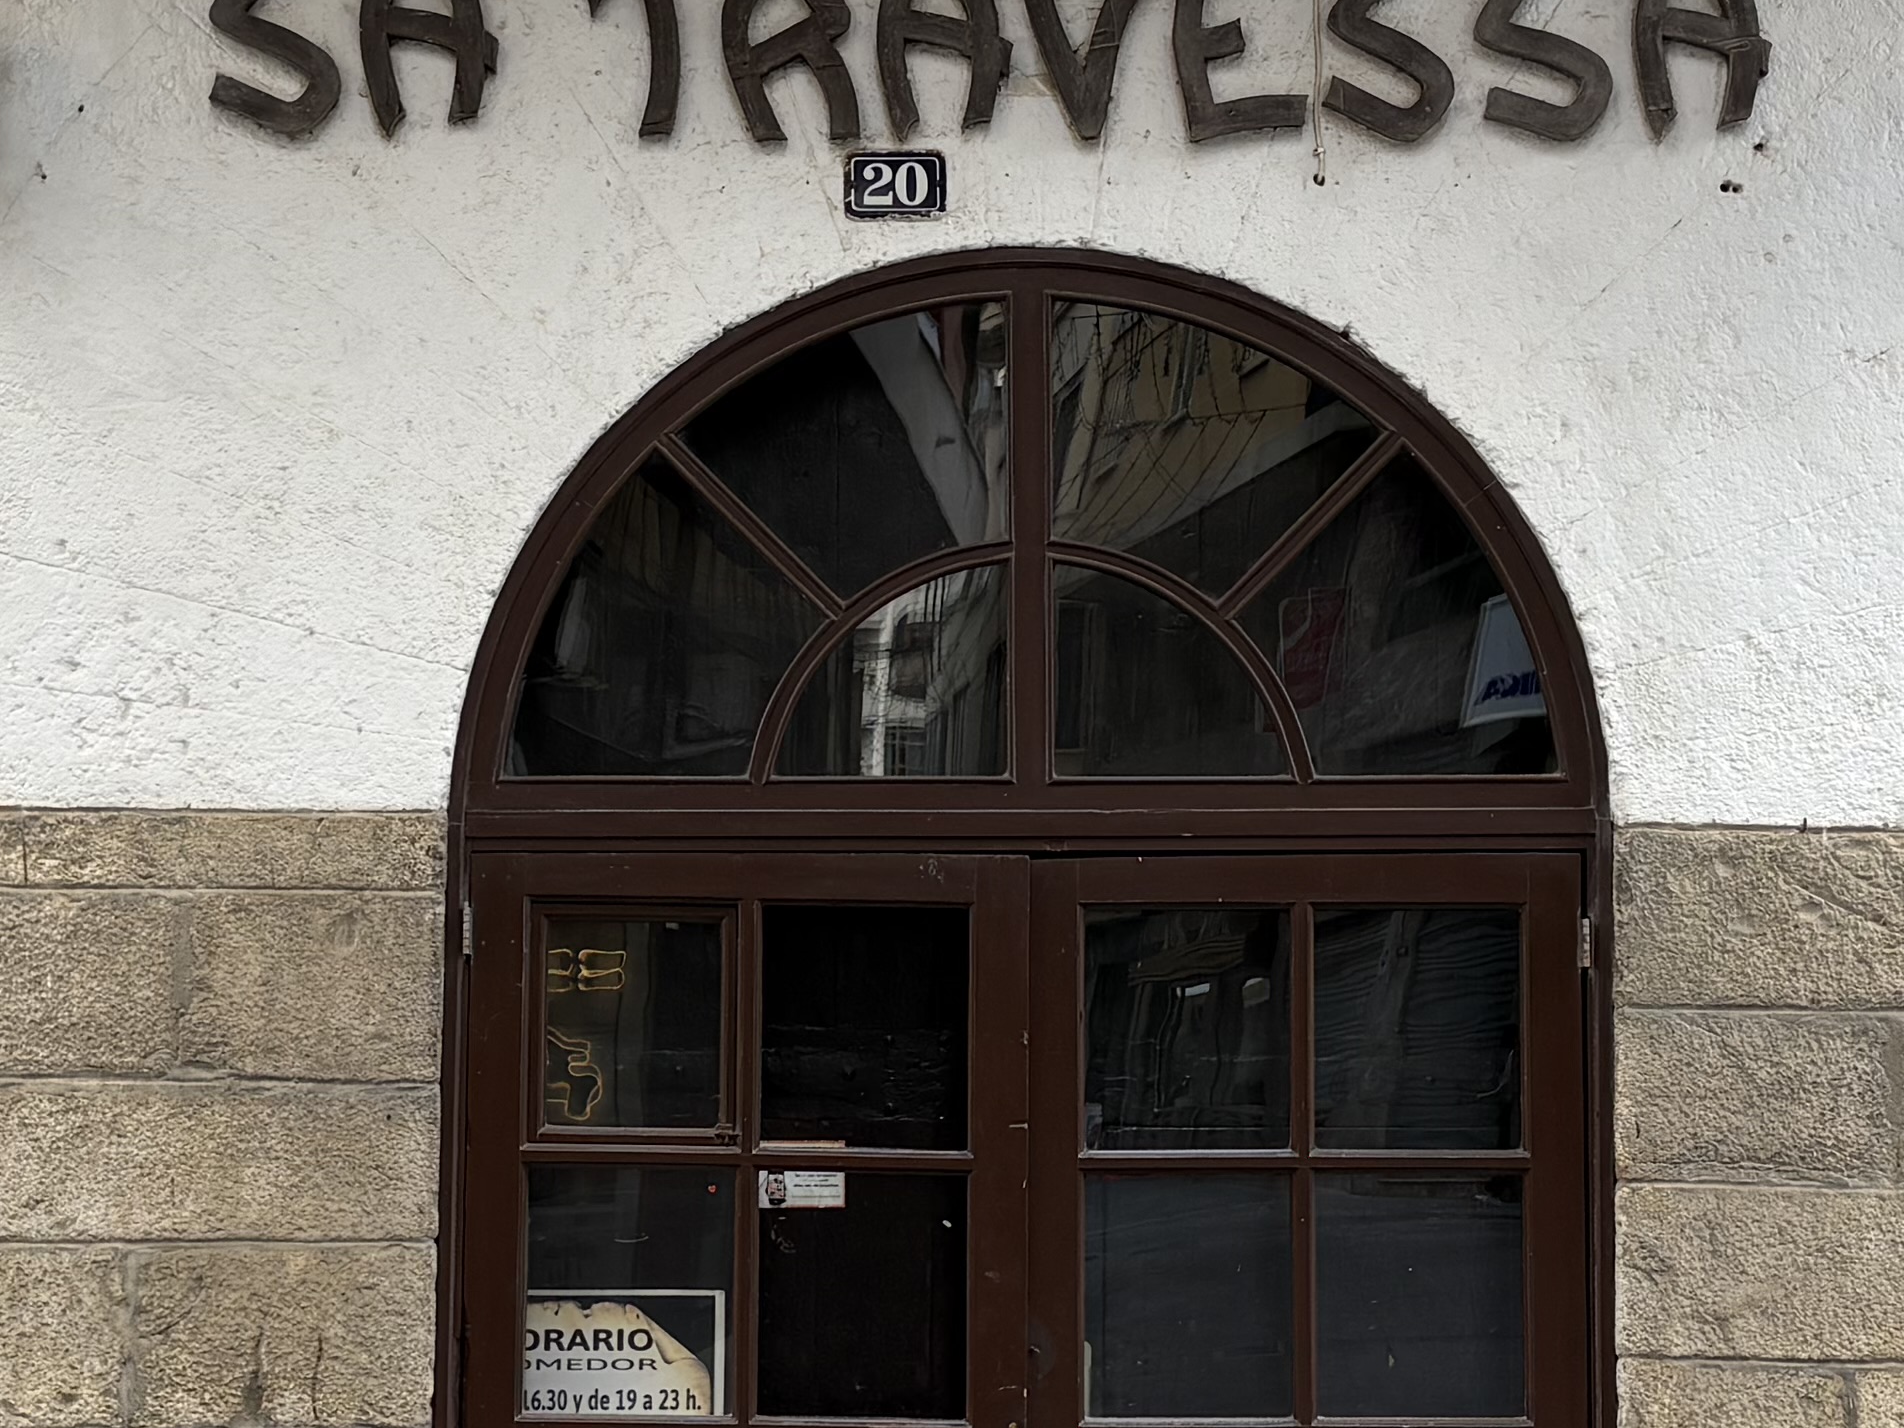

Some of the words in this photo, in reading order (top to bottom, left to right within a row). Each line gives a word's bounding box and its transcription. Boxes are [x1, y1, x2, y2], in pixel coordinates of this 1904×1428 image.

[862, 161, 929, 207] 20
[526, 1328, 655, 1352] ORARIO
[573, 1394, 584, 1414] y
[588, 1388, 611, 1411] de
[615, 1389, 638, 1411] 19
[643, 1395, 653, 1411] a
[658, 1389, 680, 1411] 23
[686, 1388, 702, 1411] h.
